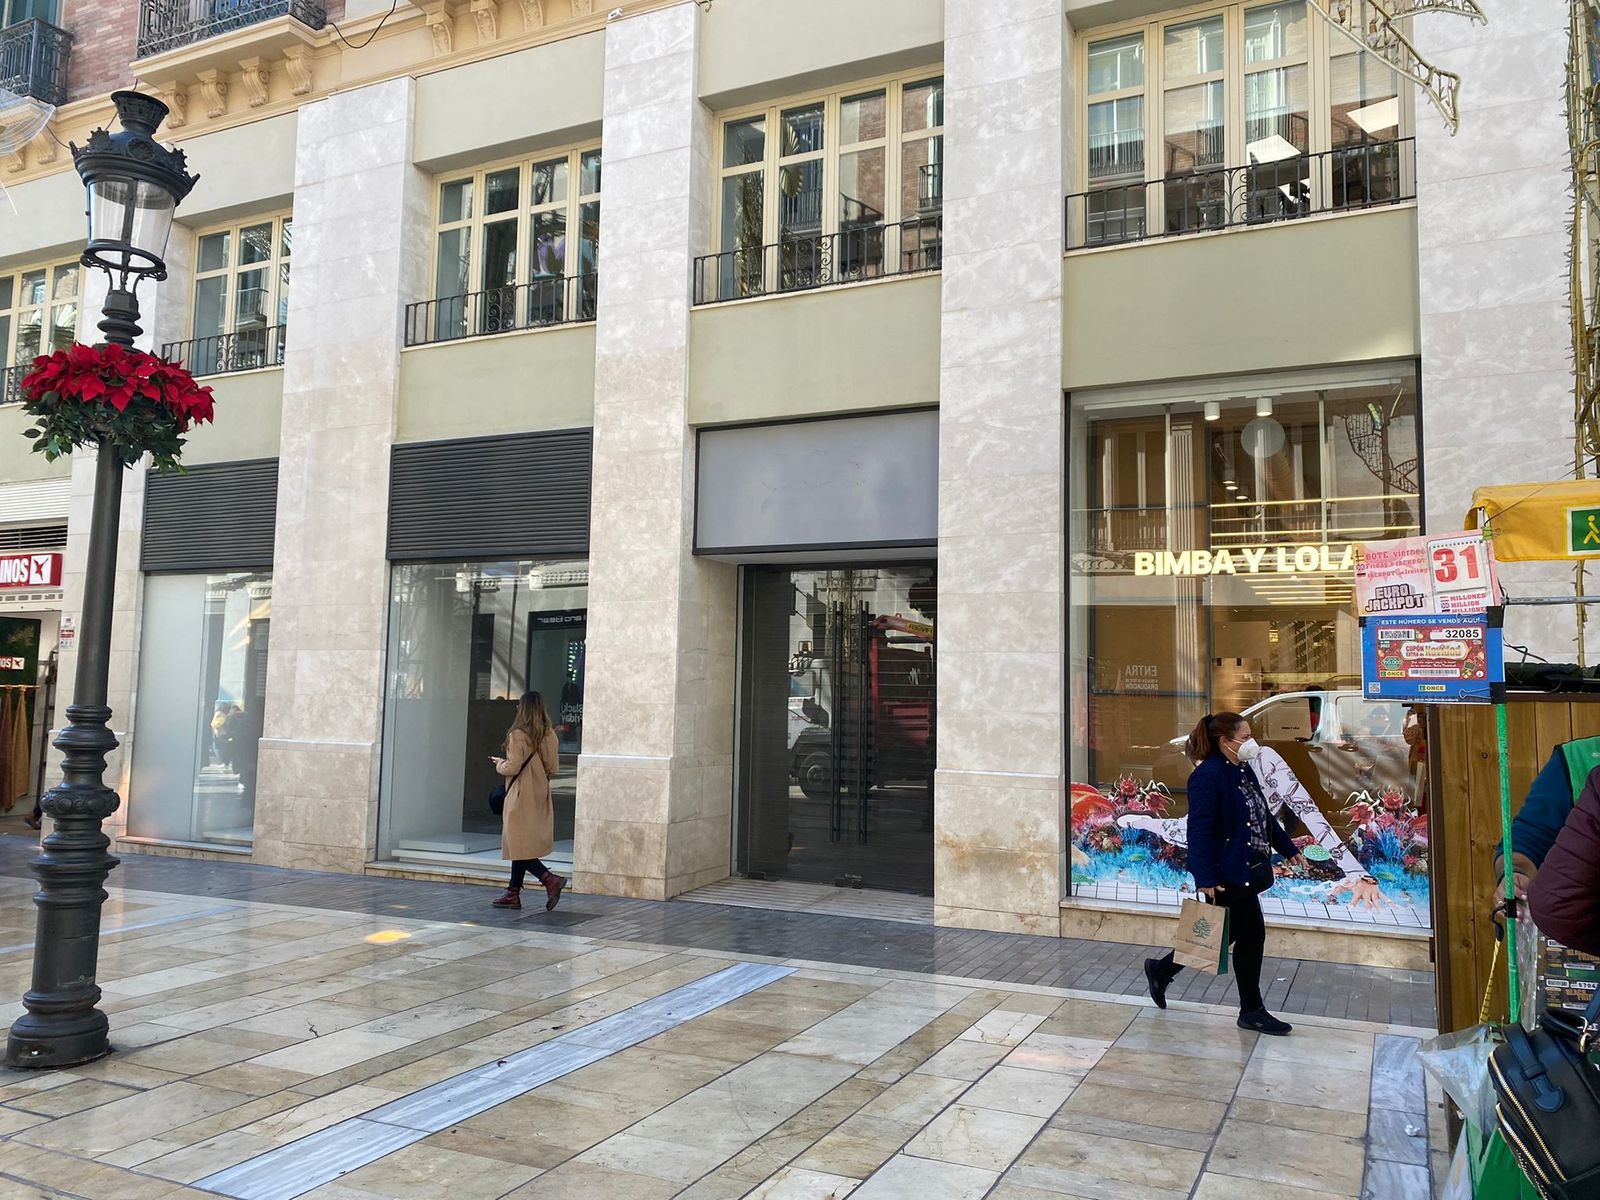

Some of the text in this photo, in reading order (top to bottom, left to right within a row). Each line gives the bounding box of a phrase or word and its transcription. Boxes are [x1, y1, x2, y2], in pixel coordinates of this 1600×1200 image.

[1134, 549, 1237, 576] BIMBA
[1241, 548, 1267, 573] Y
[1433, 545, 1479, 582] 31
[1375, 584, 1410, 600] EURO
[1450, 593, 1487, 601] MILLONES
[1365, 593, 1424, 613] JACKPOT
[1451, 600, 1480, 608] MILLION
[1398, 617, 1426, 625] NÚMERO
[1445, 629, 1479, 639] 32085
